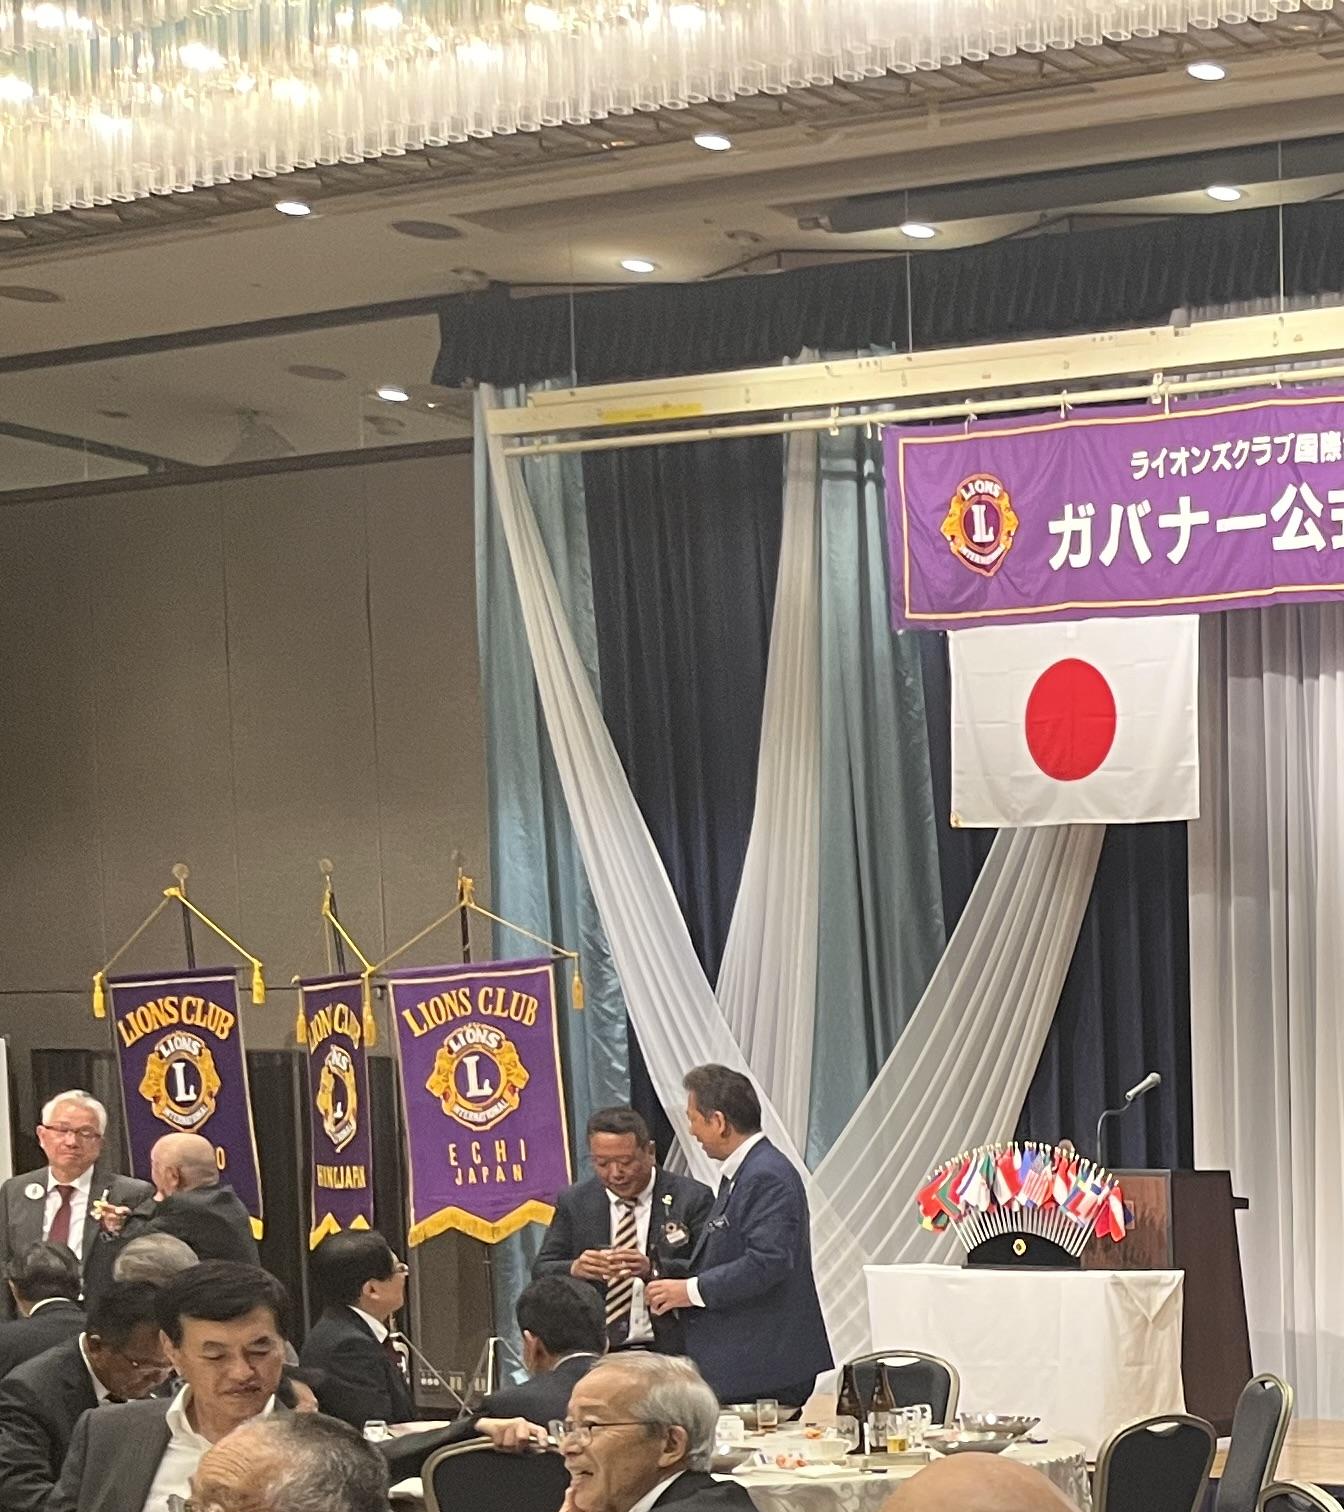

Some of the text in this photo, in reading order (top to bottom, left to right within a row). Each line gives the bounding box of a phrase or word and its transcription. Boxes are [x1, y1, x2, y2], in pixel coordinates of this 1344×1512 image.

[960, 480, 1001, 501] LIONS
[971, 504, 995, 542] L
[117, 996, 236, 1048] LIONS CLUB
[402, 986, 539, 1038] LIONS CLUB
[158, 1036, 202, 1058] LIONS
[449, 1026, 500, 1053] LIONS
[172, 1061, 197, 1102] L
[462, 1055, 493, 1098] L
[455, 1163, 523, 1186] JAPAN
